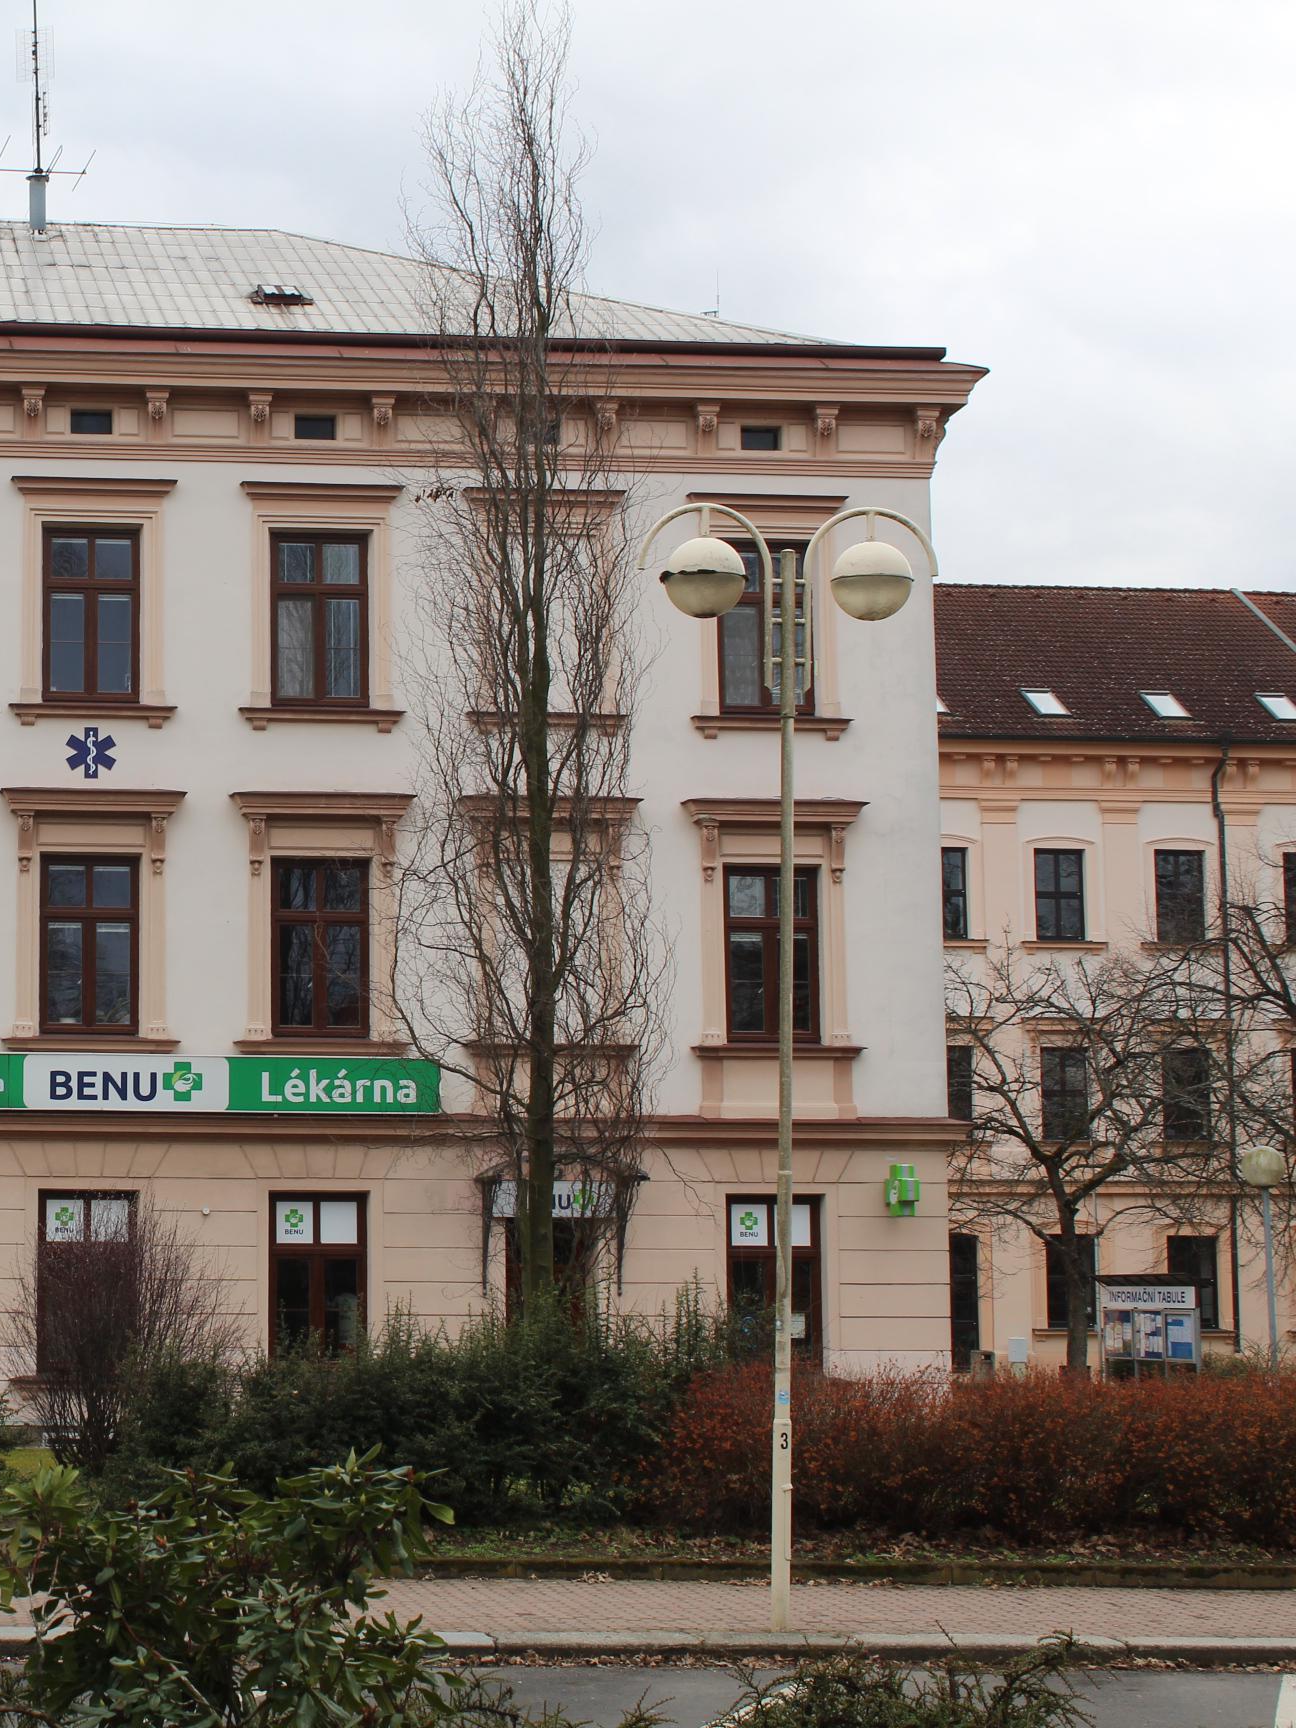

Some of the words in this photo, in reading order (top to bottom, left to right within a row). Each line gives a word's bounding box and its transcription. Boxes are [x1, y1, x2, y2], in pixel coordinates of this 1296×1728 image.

[49, 1070, 157, 1102] BENU
[261, 1068, 417, 1104] Lékárna
[1110, 1288, 1156, 1303] INFORMAČNÍ
[1158, 1291, 1186, 1303] TABULE
[780, 1432, 788, 1450] 3
